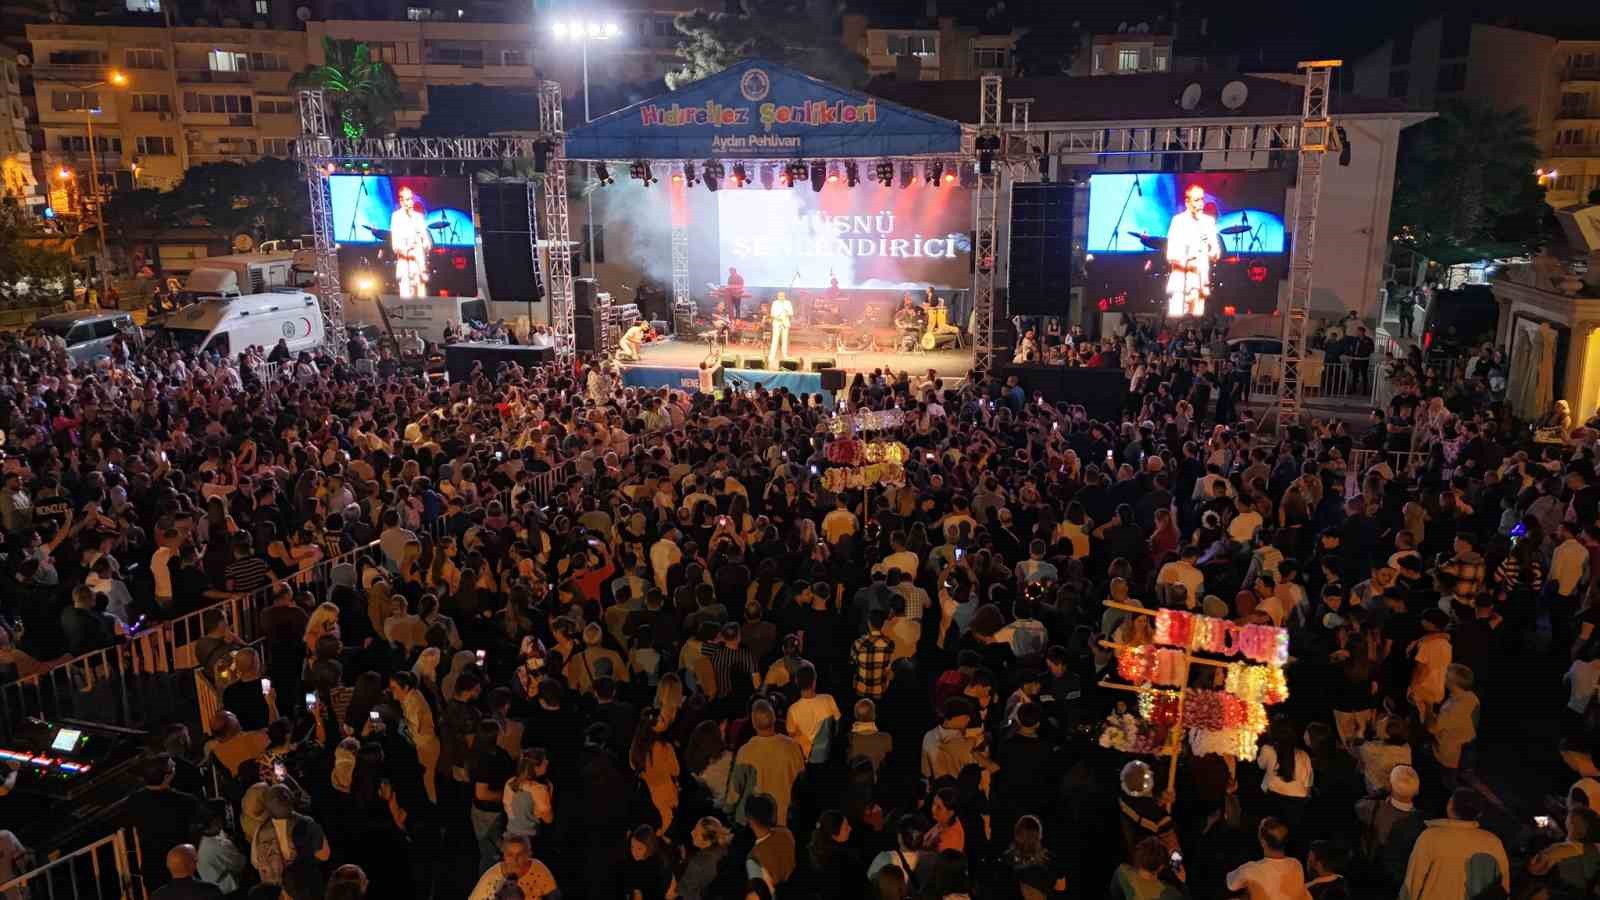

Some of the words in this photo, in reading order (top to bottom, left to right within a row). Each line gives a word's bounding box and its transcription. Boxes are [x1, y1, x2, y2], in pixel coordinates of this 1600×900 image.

[640, 100, 750, 127] Hıdırellez
[760, 98, 877, 132] Şenlikleri
[712, 134, 746, 150] Aydın
[749, 134, 800, 147] Pehlivan
[733, 233, 957, 259] ŞEENDİRİCİ
